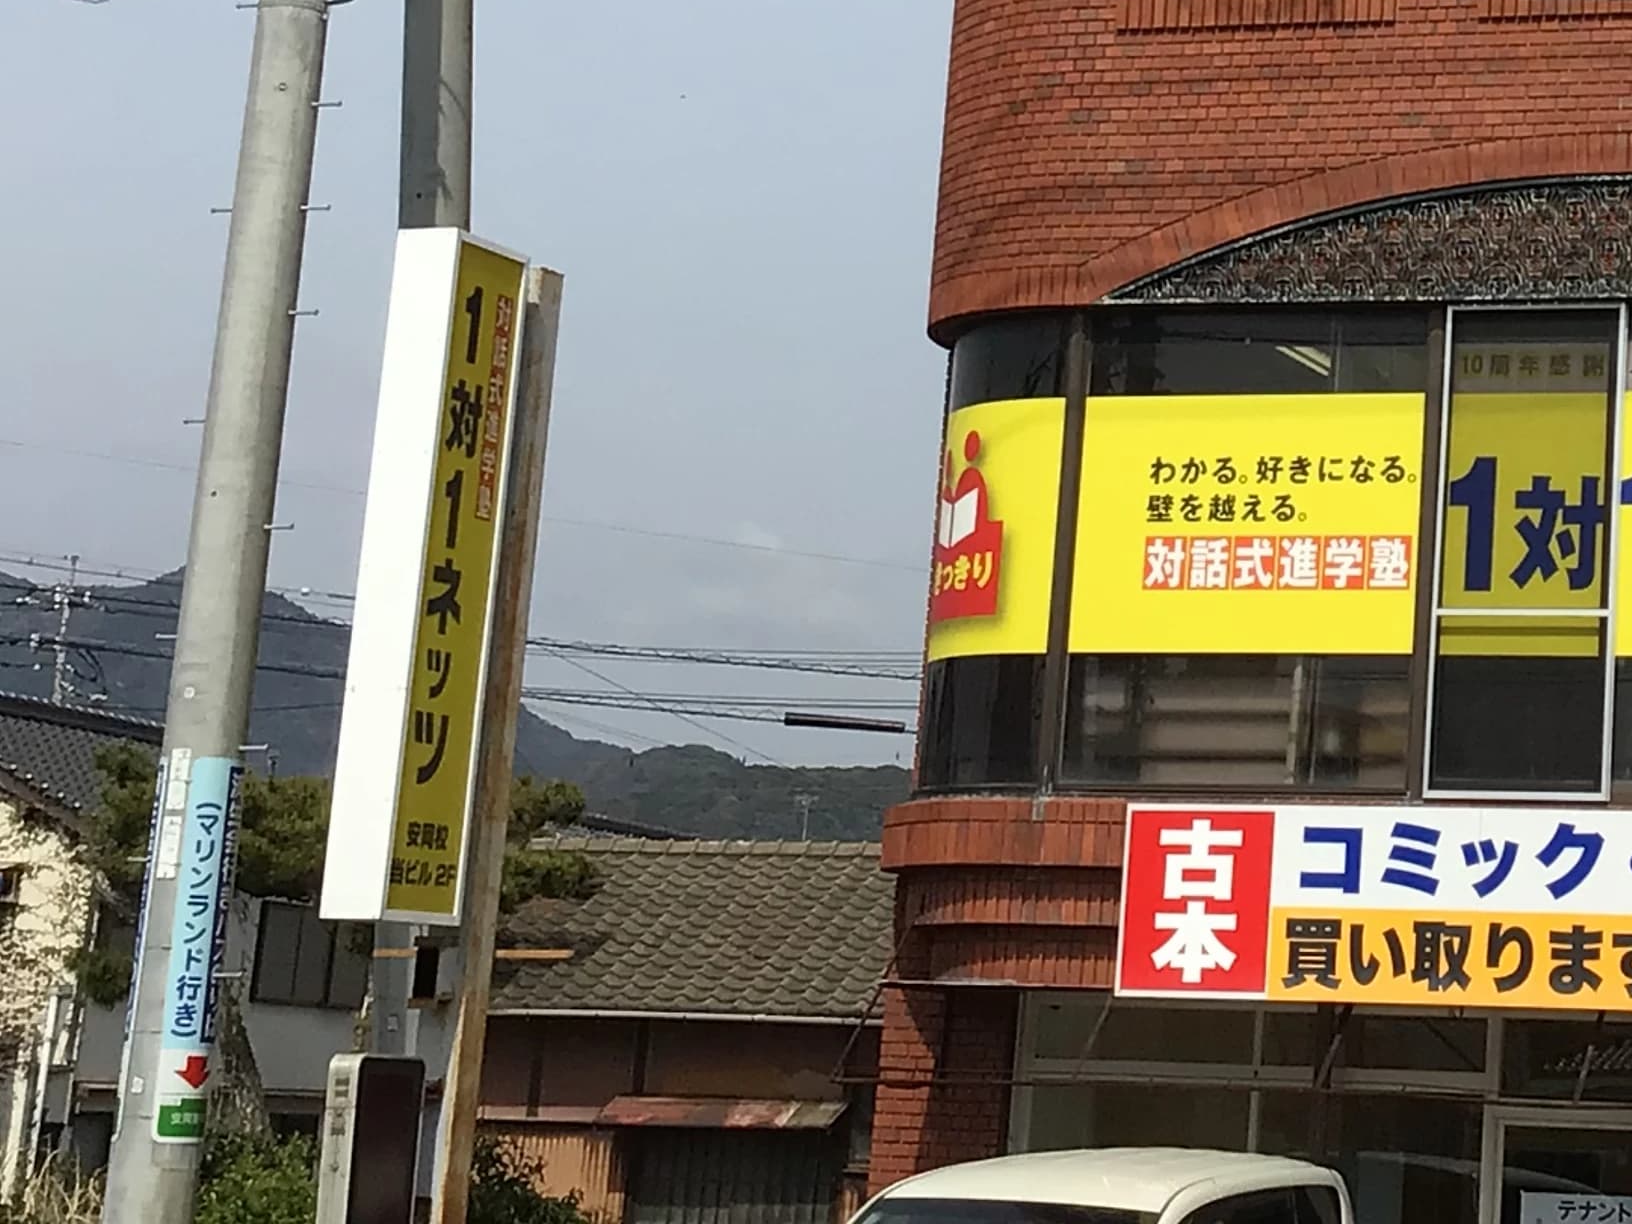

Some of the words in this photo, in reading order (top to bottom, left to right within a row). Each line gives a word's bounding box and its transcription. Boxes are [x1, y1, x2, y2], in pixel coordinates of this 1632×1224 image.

[1146, 493, 1308, 523] 壁を越える。
[413, 285, 484, 786] 1対1ネッツ
[1144, 537, 1410, 588] 対話式進学塾
[1149, 818, 1246, 985] 古本
[1557, 1199, 1632, 1224] テナント
